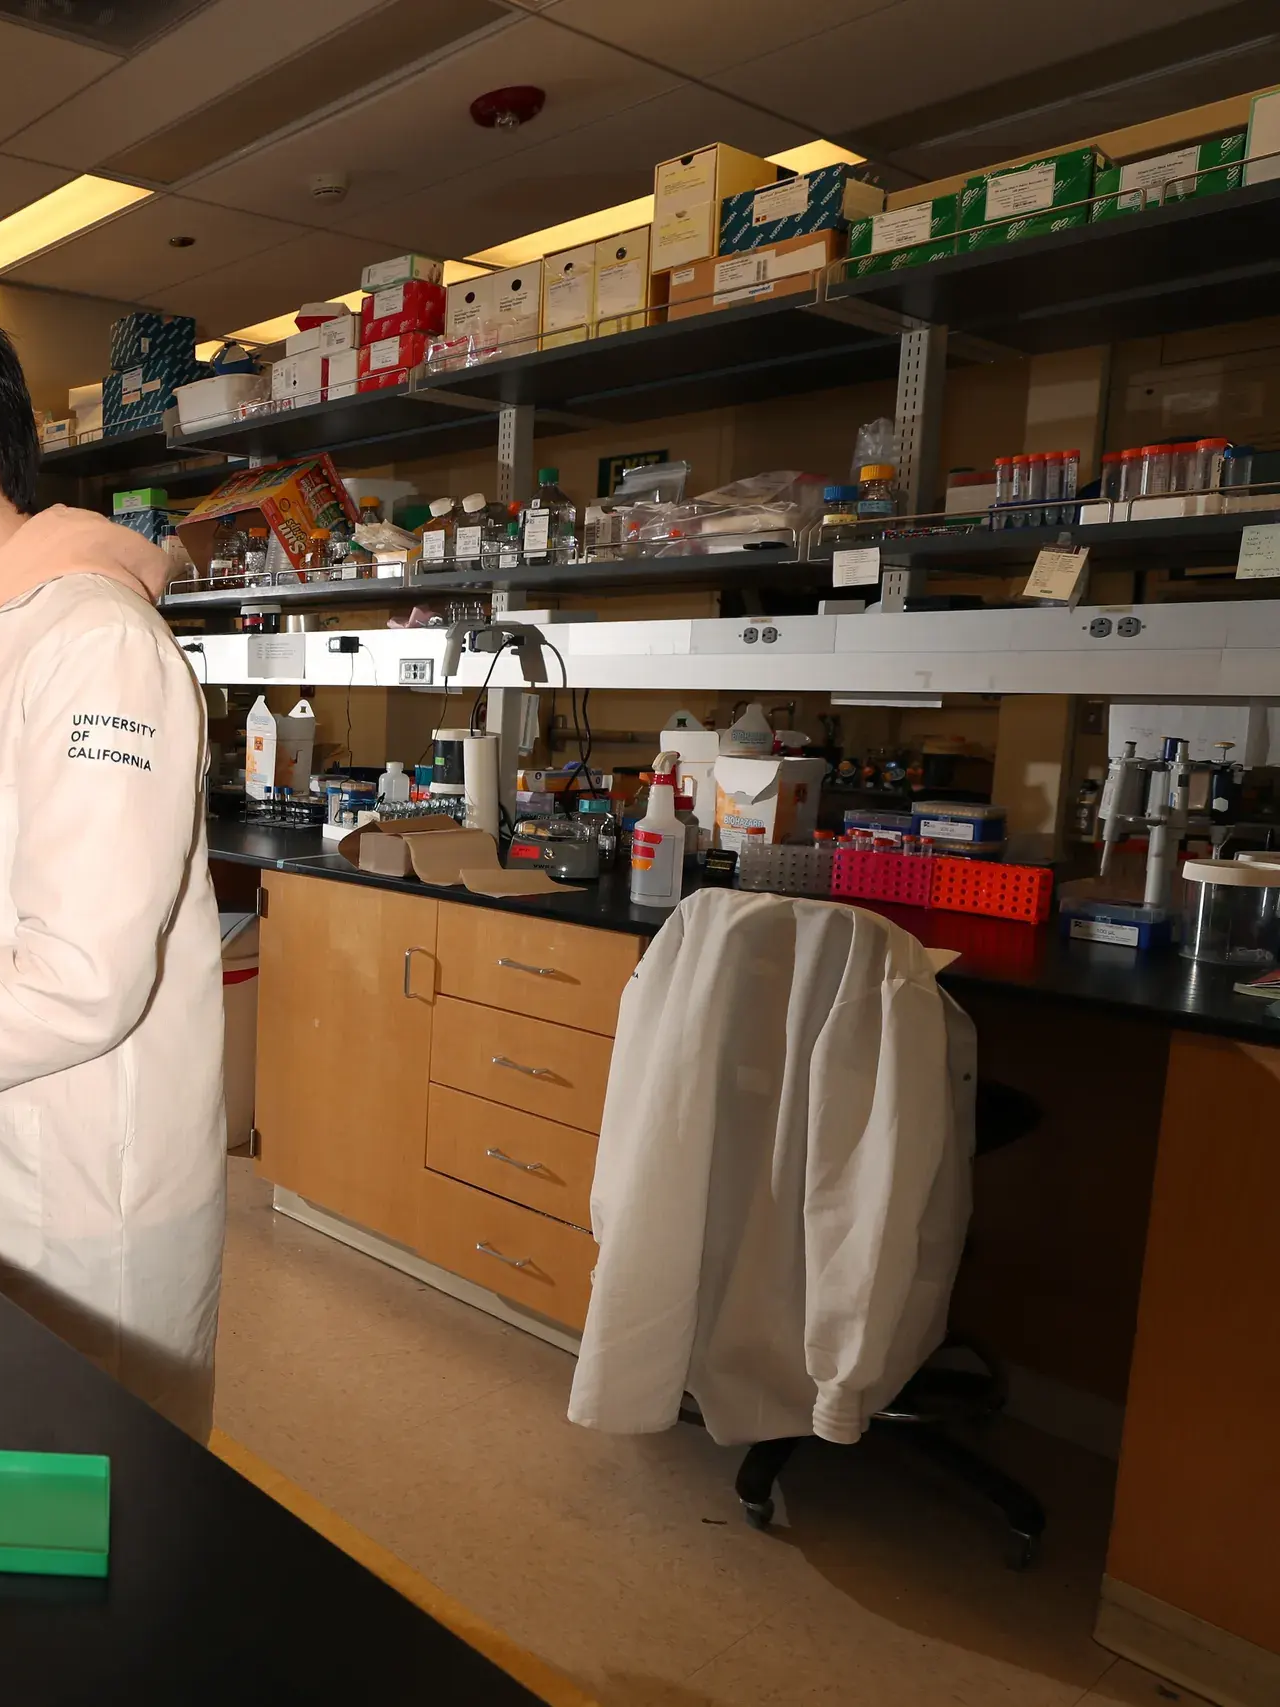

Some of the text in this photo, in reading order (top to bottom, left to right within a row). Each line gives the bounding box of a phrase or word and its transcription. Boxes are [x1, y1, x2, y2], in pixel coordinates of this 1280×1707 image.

[820, 182, 841, 206] QIAGEN
[732, 221, 751, 244] QIAGEN
[769, 216, 789, 240] QIAGEN
[809, 211, 829, 234] QIAGEN
[277, 522, 306, 555] Sun
[71, 730, 90, 742] OF
[73, 714, 156, 738] UNIVERSITY
[67, 746, 152, 772] CALIFORNIA
[723, 814, 764, 828] BIOHAZARD
